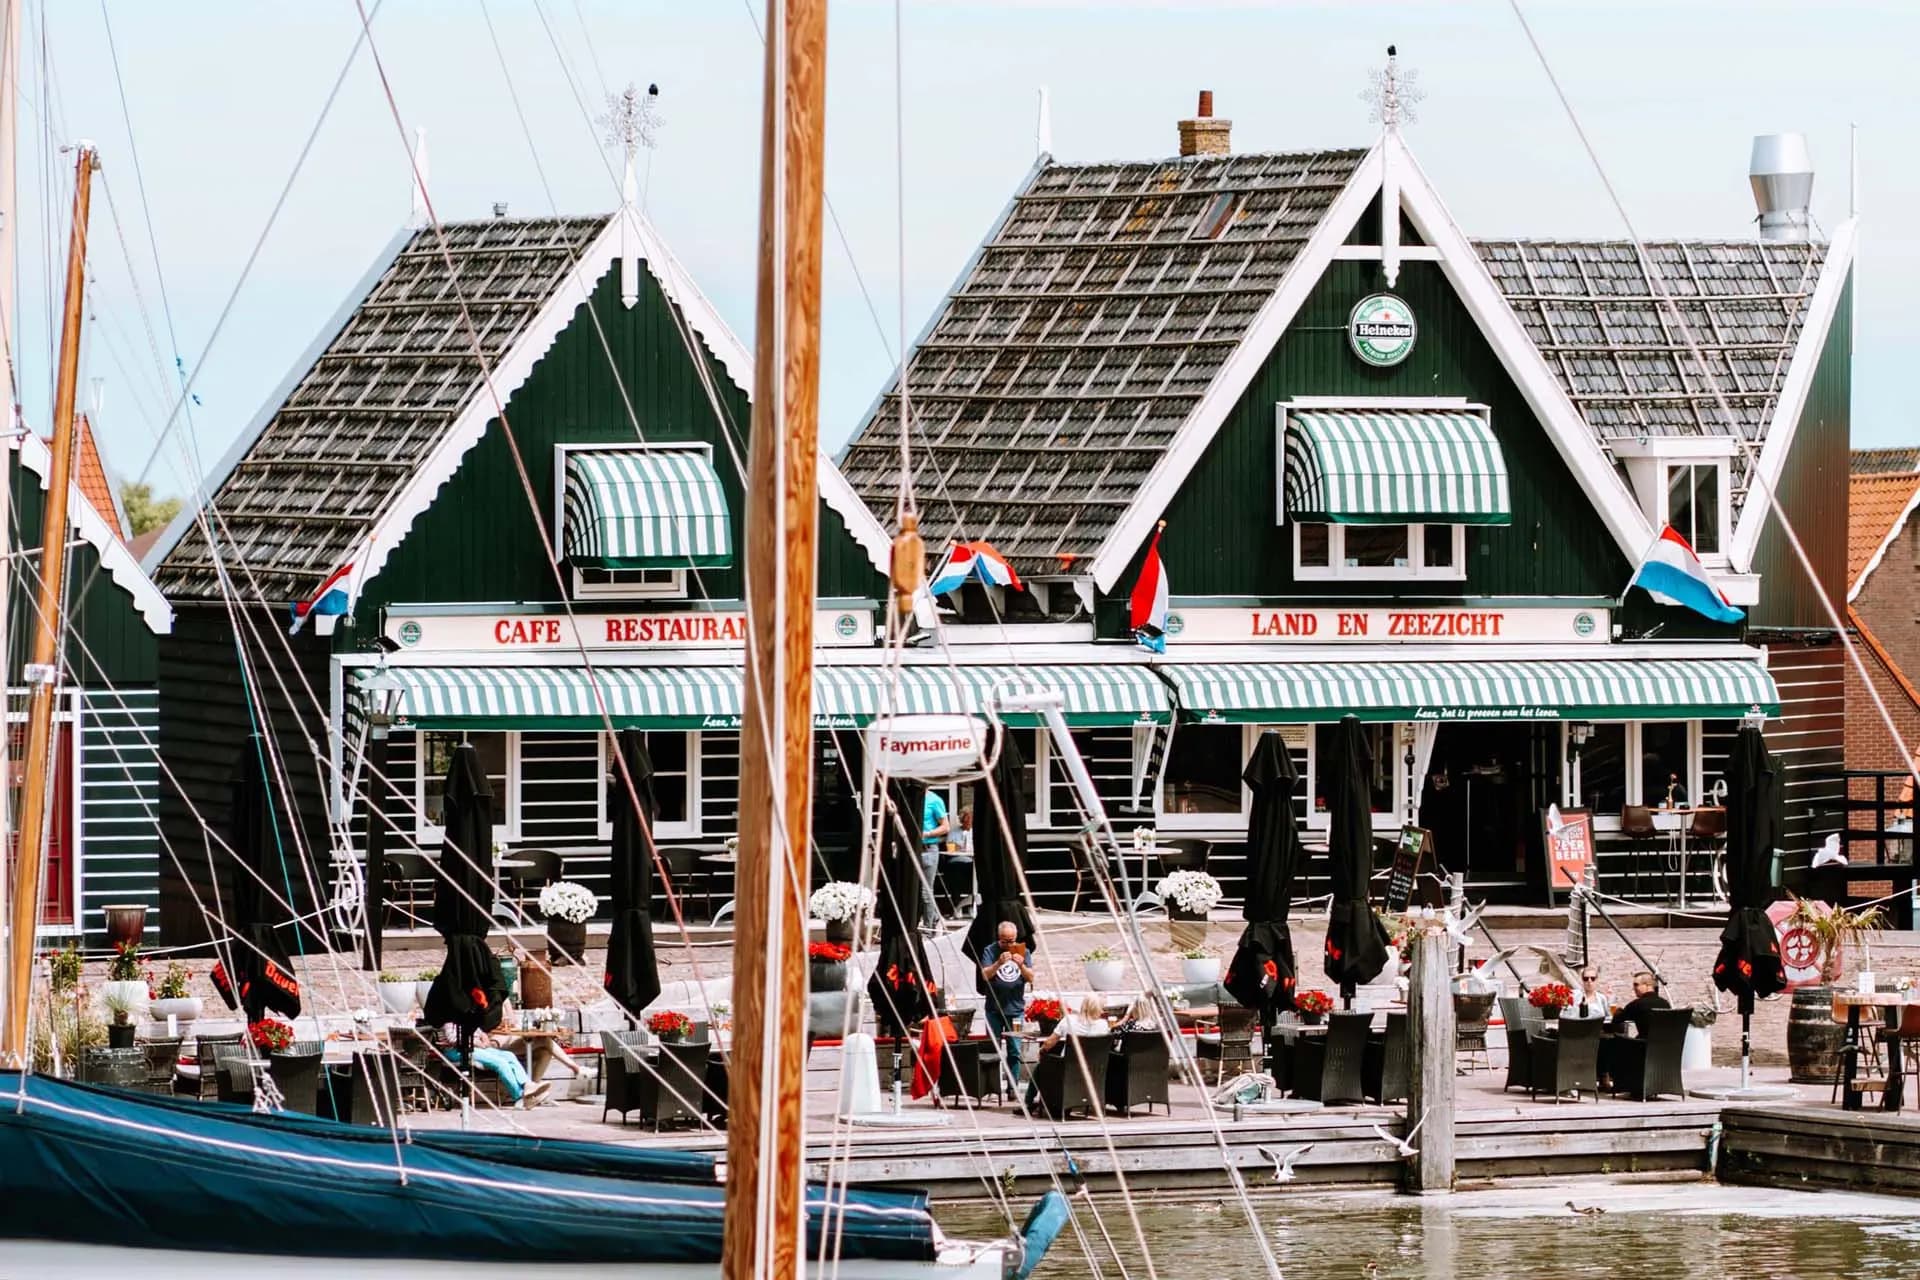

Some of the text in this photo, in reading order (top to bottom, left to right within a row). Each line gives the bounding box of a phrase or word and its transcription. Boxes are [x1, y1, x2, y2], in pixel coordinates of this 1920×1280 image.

[1359, 324, 1411, 336] Heineken
[494, 619, 560, 644] CAFE
[1252, 613, 1504, 636] LAND EN ZEEZICHT
